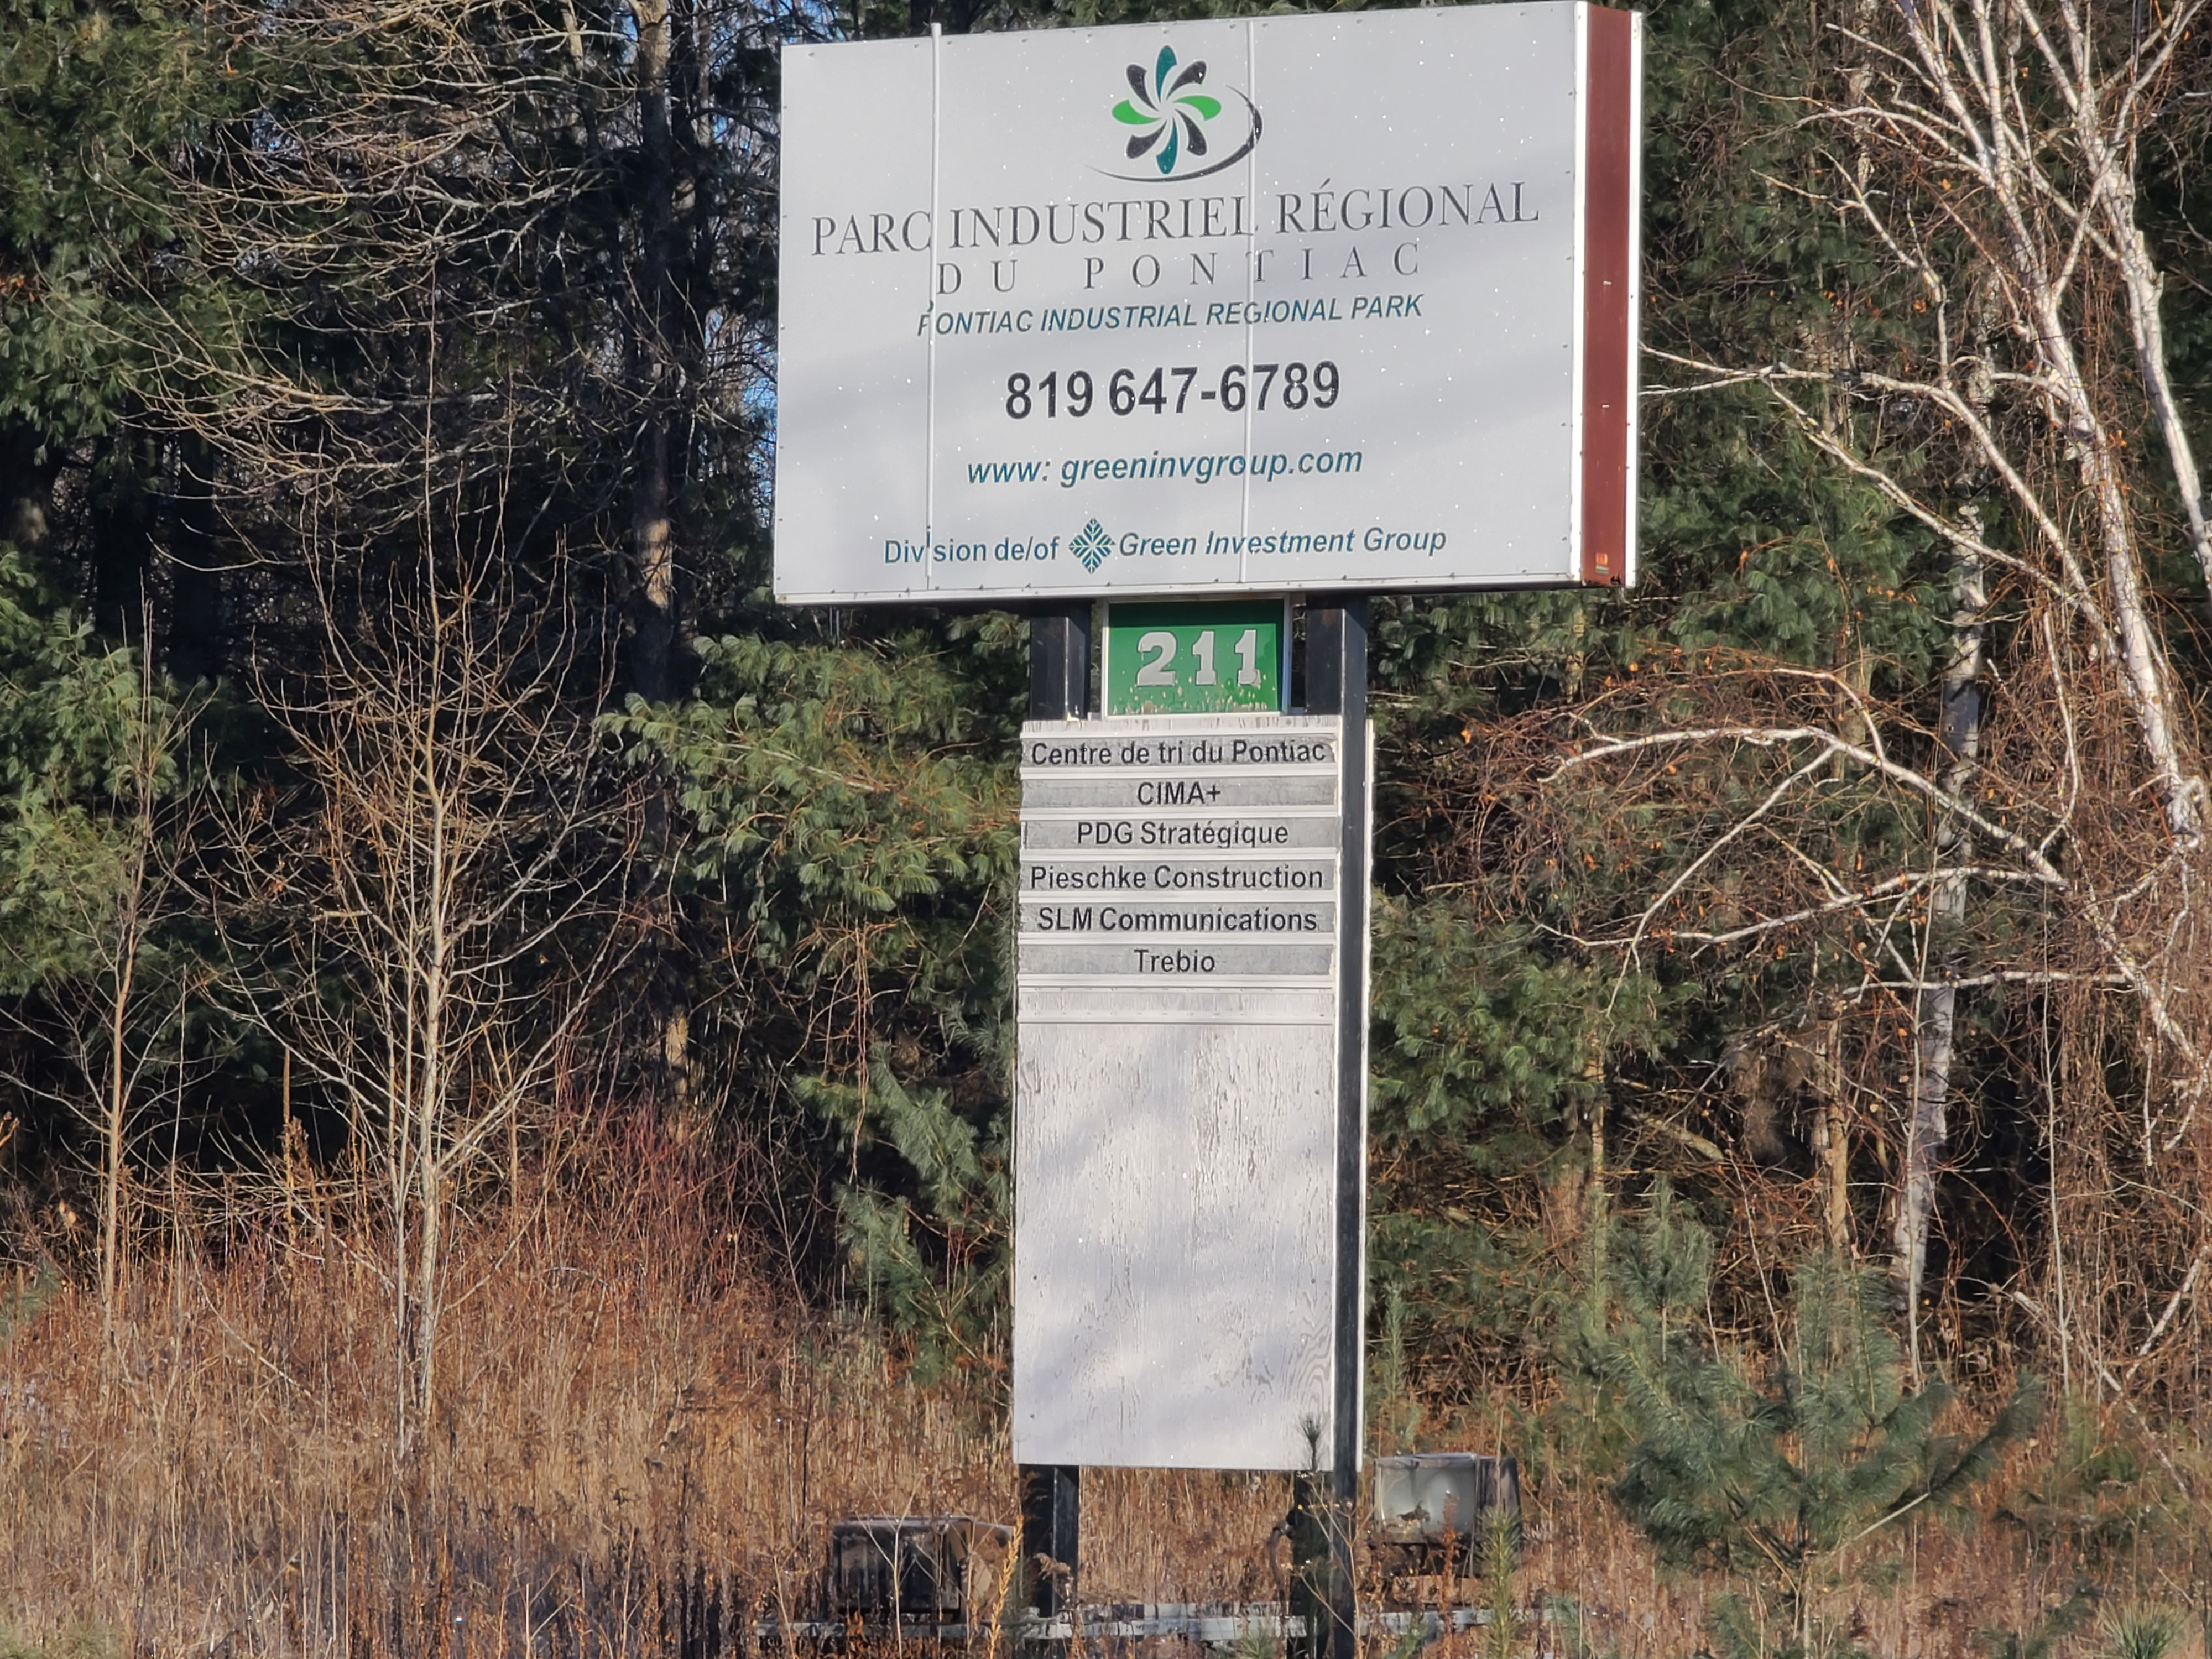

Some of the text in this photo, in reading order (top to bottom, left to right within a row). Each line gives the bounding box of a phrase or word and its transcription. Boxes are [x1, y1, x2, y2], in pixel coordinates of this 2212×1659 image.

[811, 179, 1540, 255] PARC INDUSTRIEL RÉGIONAL
[936, 242, 1422, 293] DU PONTIAC
[916, 293, 1424, 338] PONTIAC INDUSTRIAL REGIONAL PARK
[1005, 361, 1340, 419] 819 647-6789
[967, 448, 1363, 487] www: greeninvgroup.com
[995, 535, 1060, 563] de/of
[1119, 530, 1198, 559] Green
[1206, 529, 1355, 555] Investment
[1364, 526, 1446, 557] Group
[1136, 629, 1261, 686] 211
[1031, 740, 1326, 765] Centre de tri du Pontiac
[1137, 781, 1221, 805] CIMA+
[1077, 821, 1288, 848] PDG Stratégique
[1031, 865, 1323, 889] Pieschke Construction
[1038, 907, 1317, 931] SLM Communications
[1134, 948, 1215, 973] Trebio
